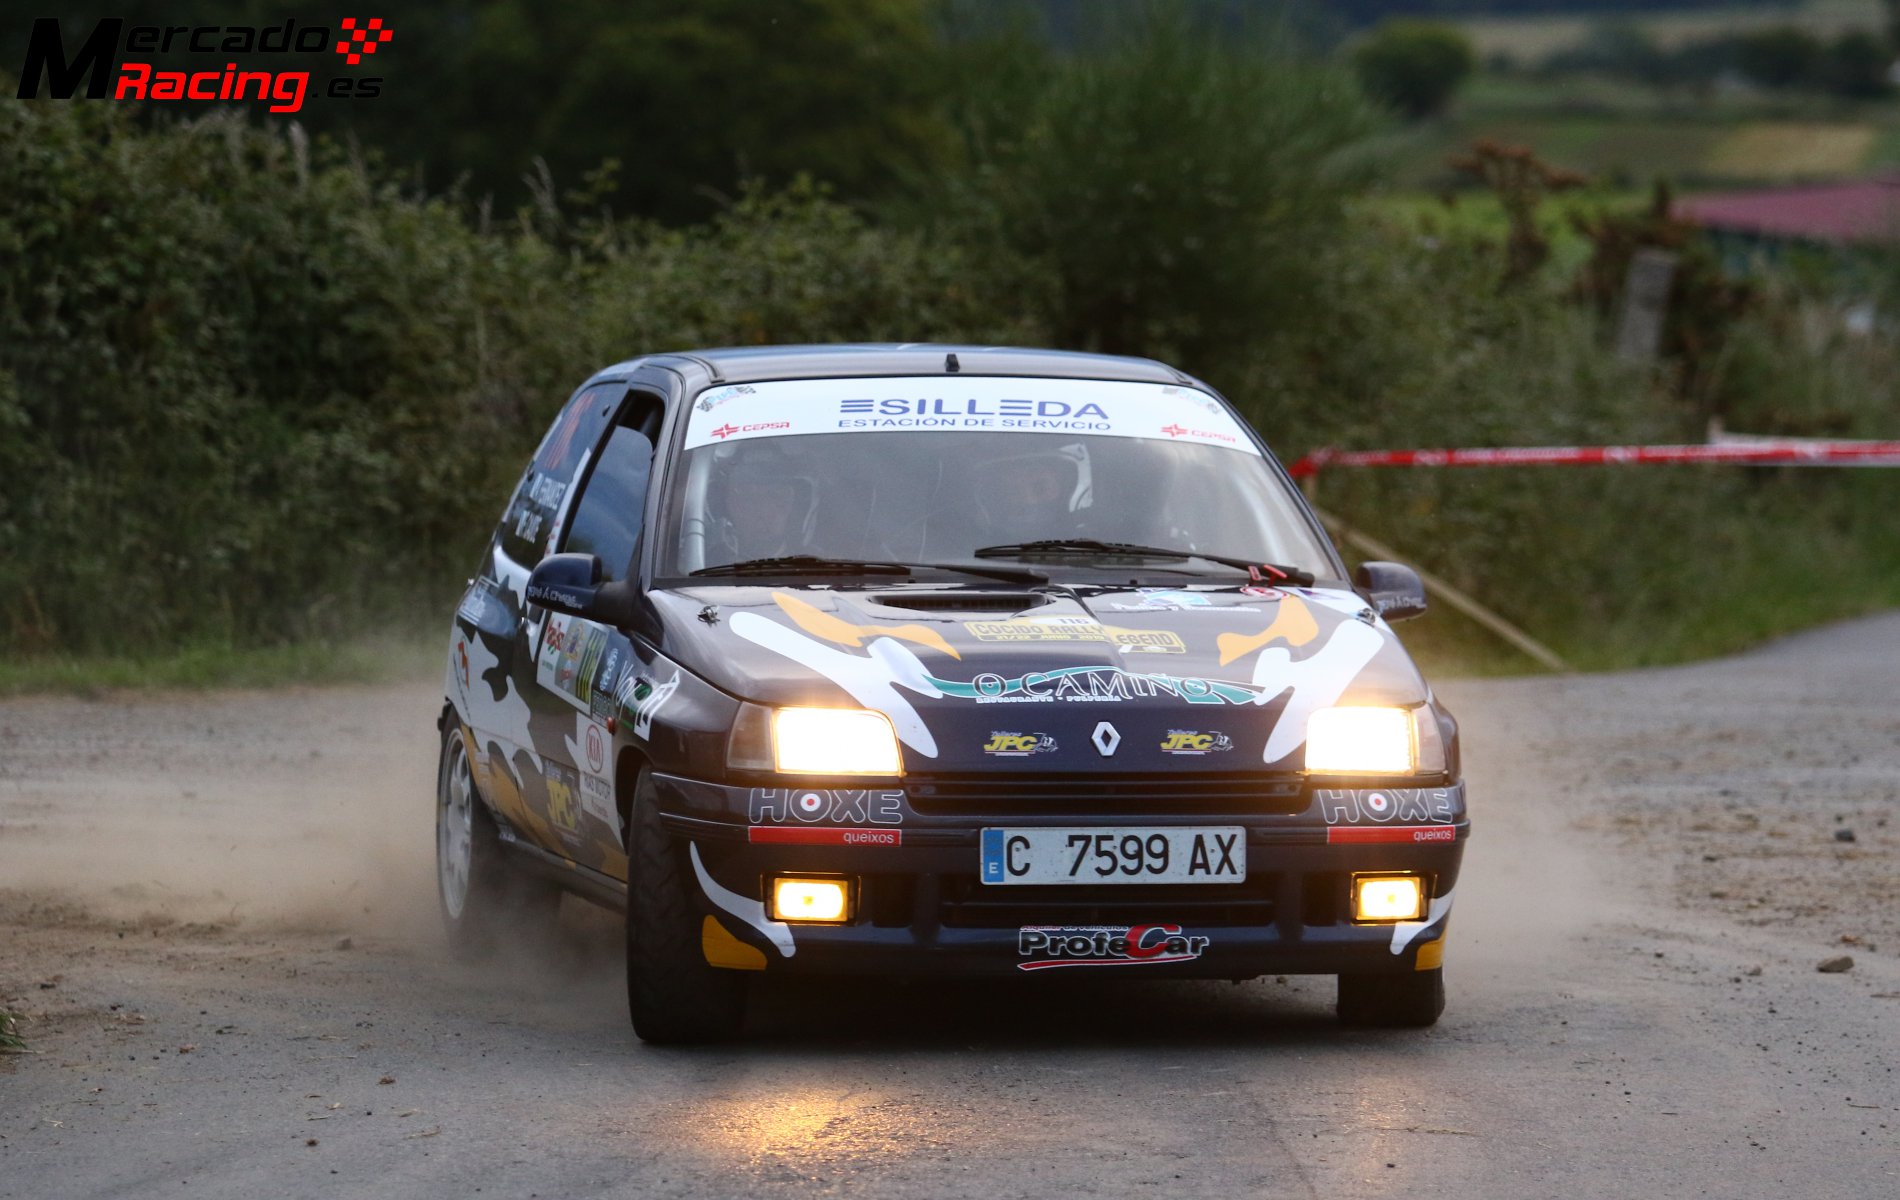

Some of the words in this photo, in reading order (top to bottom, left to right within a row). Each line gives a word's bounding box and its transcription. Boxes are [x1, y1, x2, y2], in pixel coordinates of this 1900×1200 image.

[840, 399, 1109, 420] ESILLEDA
[743, 421, 790, 432] CEPSA
[838, 417, 956, 428] ESTACIÓN
[964, 418, 995, 427] DE
[1002, 418, 1111, 431] SERVICIO
[1191, 429, 1237, 443] CEPSA
[974, 624, 1044, 635] COCIDO
[1048, 625, 1105, 635] RALLY
[1114, 631, 1174, 646] EGEND
[972, 673, 1007, 696] O
[984, 736, 1038, 751] JPC
[1160, 734, 1214, 750] JPC
[749, 788, 904, 824] HOXE
[1318, 788, 1454, 824] HOXE
[843, 830, 895, 844] queixos
[1413, 829, 1452, 841] queixos
[1006, 835, 1031, 877] C
[1067, 834, 1170, 876] 7599
[1188, 833, 1238, 876] AX
[988, 862, 999, 874] E
[1018, 923, 1210, 959] ProfeCar
